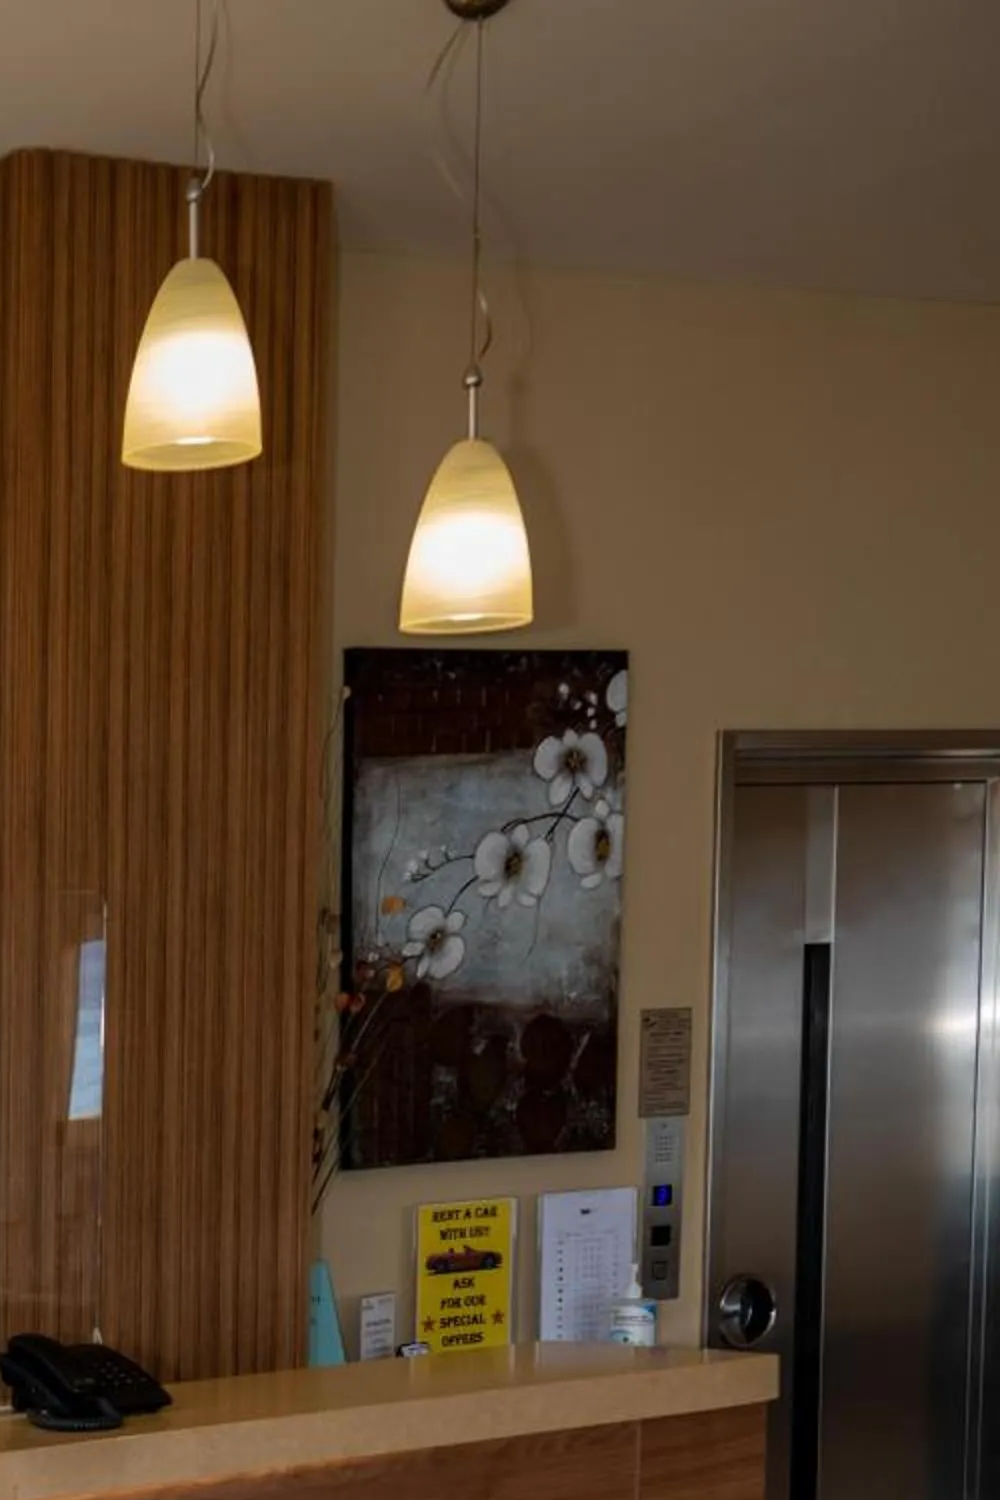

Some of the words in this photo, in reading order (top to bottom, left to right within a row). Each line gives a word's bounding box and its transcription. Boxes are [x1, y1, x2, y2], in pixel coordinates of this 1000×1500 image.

[432, 1209, 461, 1222] RENT
[463, 1208, 472, 1219] A
[475, 1205, 498, 1218] CAR
[440, 1227, 466, 1241] WITH
[453, 1277, 475, 1290] ASK
[440, 1298, 462, 1310] FOR
[464, 1294, 486, 1307] OUR
[439, 1313, 486, 1329] SPECIAL
[441, 1332, 484, 1347] OFFERS
